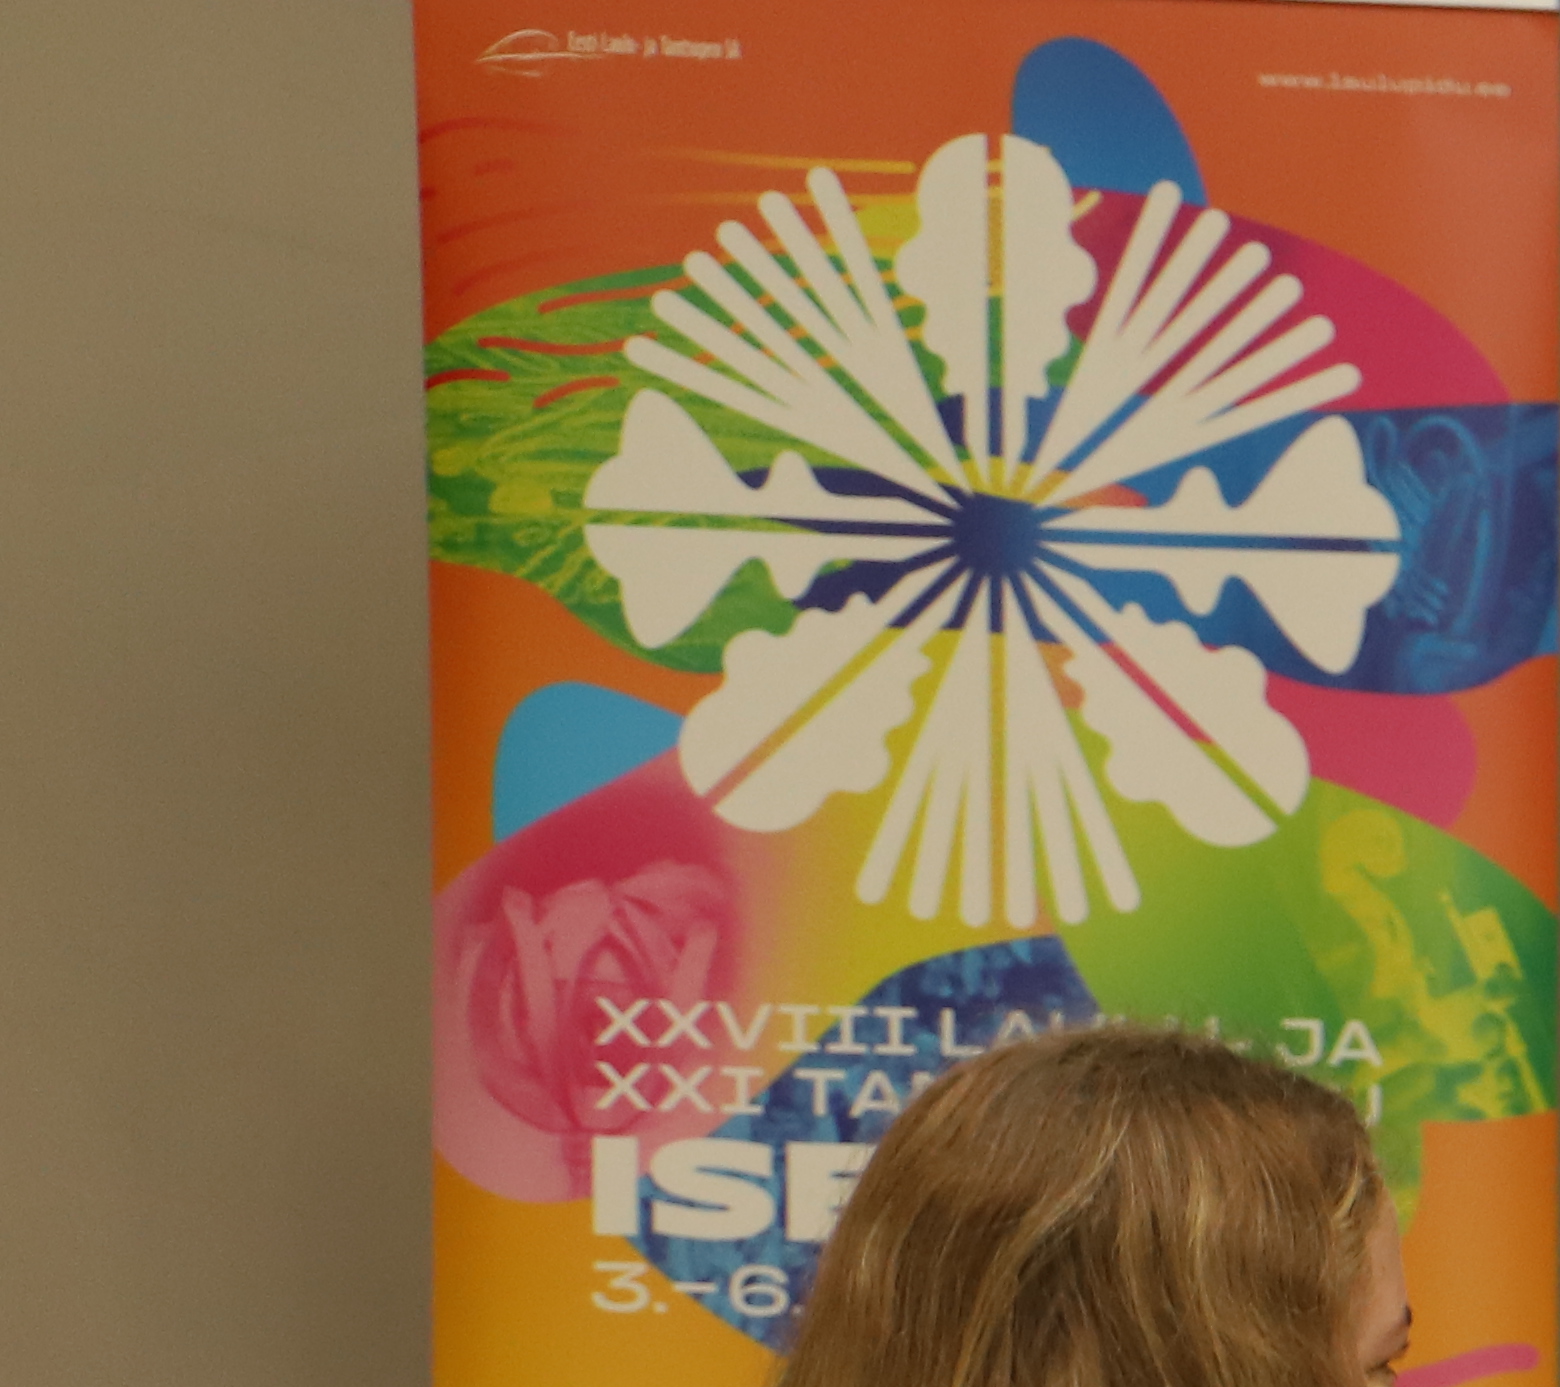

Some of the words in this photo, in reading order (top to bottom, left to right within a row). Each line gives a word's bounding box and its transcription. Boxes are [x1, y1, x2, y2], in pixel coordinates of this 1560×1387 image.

[594, 996, 919, 1056] XXVIII
[1274, 1016, 1382, 1067] JA
[594, 1060, 765, 1116] XXI
